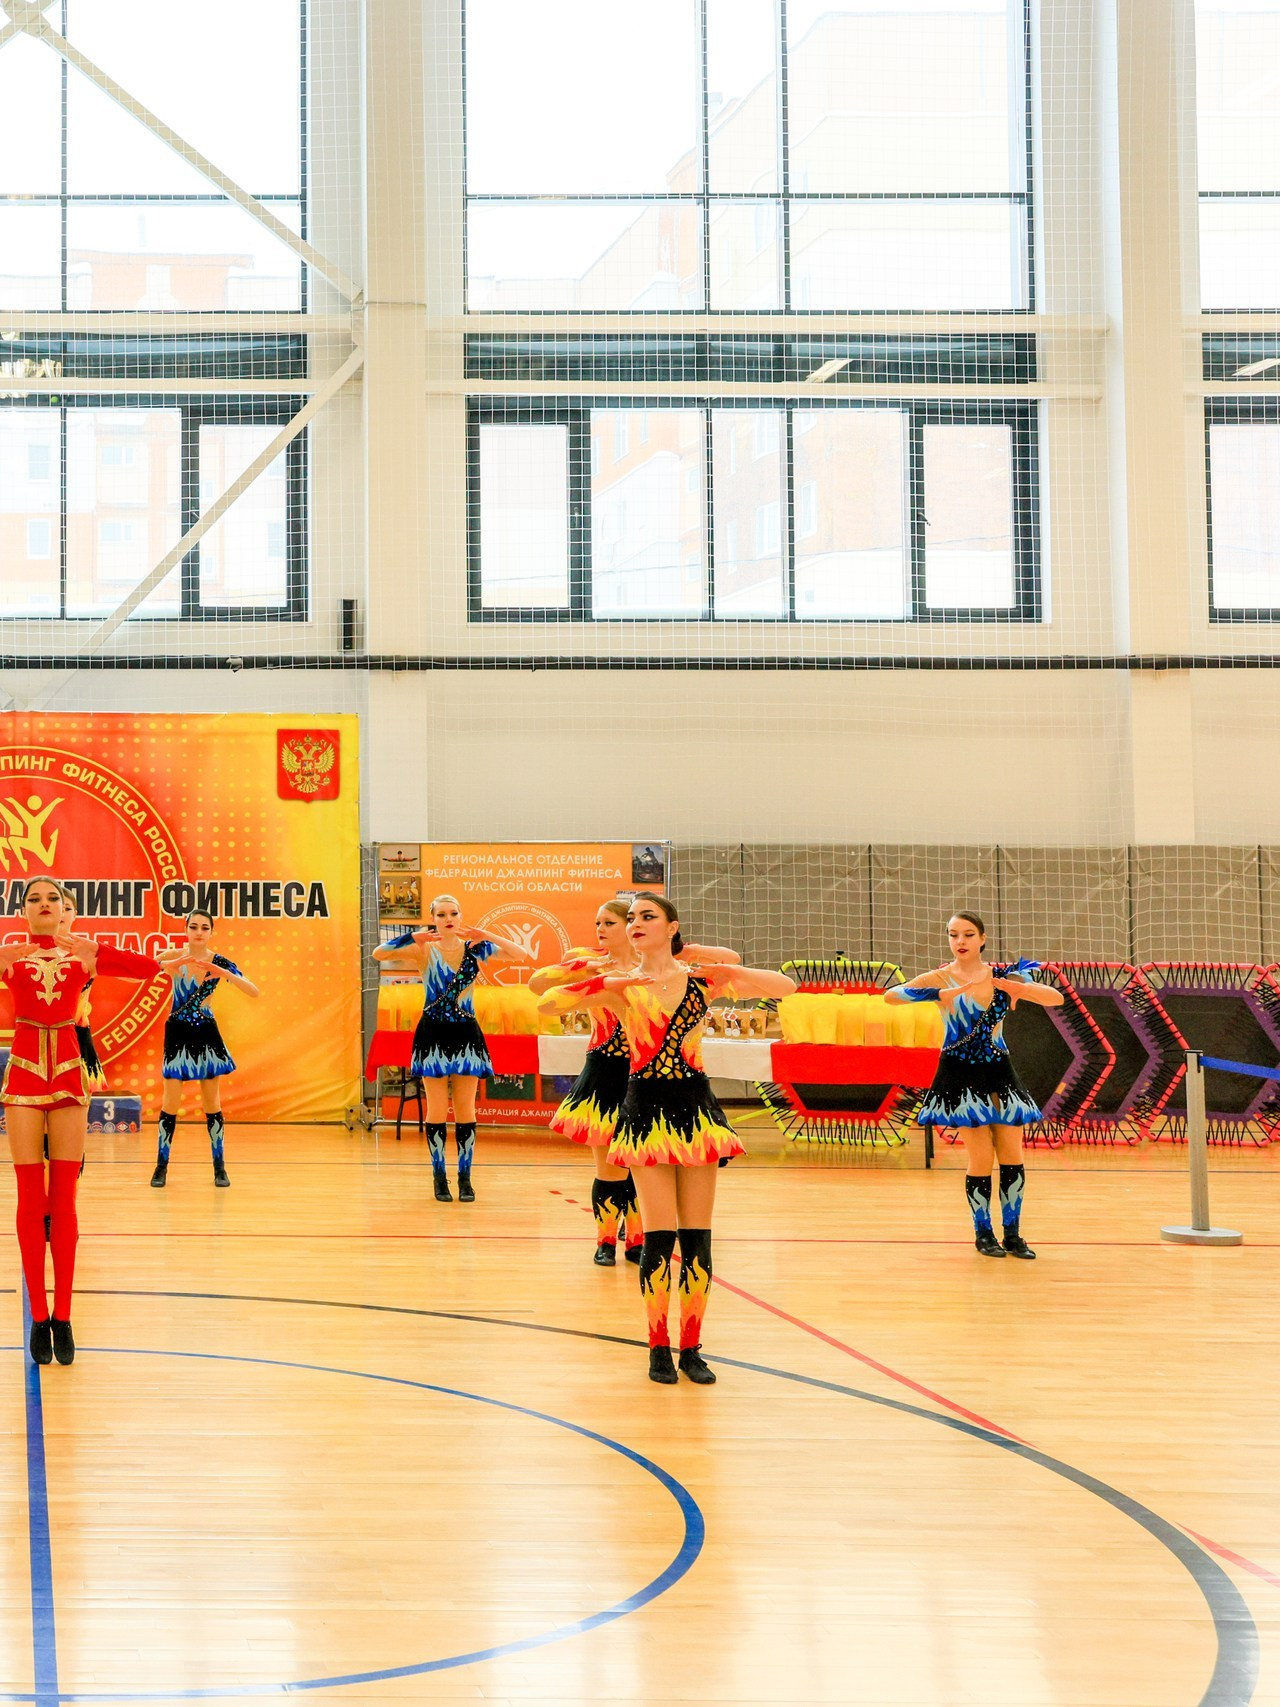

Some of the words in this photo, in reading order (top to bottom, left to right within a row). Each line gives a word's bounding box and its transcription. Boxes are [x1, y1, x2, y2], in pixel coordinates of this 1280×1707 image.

[62, 763, 148, 827] ФИТНЕСА
[143, 826, 178, 882] РОСС
[443, 854, 533, 865] РЕГИОНАЛЬНОЕ
[536, 855, 603, 865] ОТДЕЛЕНИЕ
[424, 868, 494, 879] ФЕДЕРАЦИИ
[496, 868, 564, 879] ДЖАМПИНГ
[567, 868, 623, 879] ФИТНЕСА
[463, 880, 524, 892] ТУЛЬСКОЙ
[527, 882, 583, 892] ОБЛАСТИ
[161, 879, 330, 919] ФИТНЕСА
[100, 973, 169, 1052] FEDERAT
[103, 1100, 115, 1121] 3
